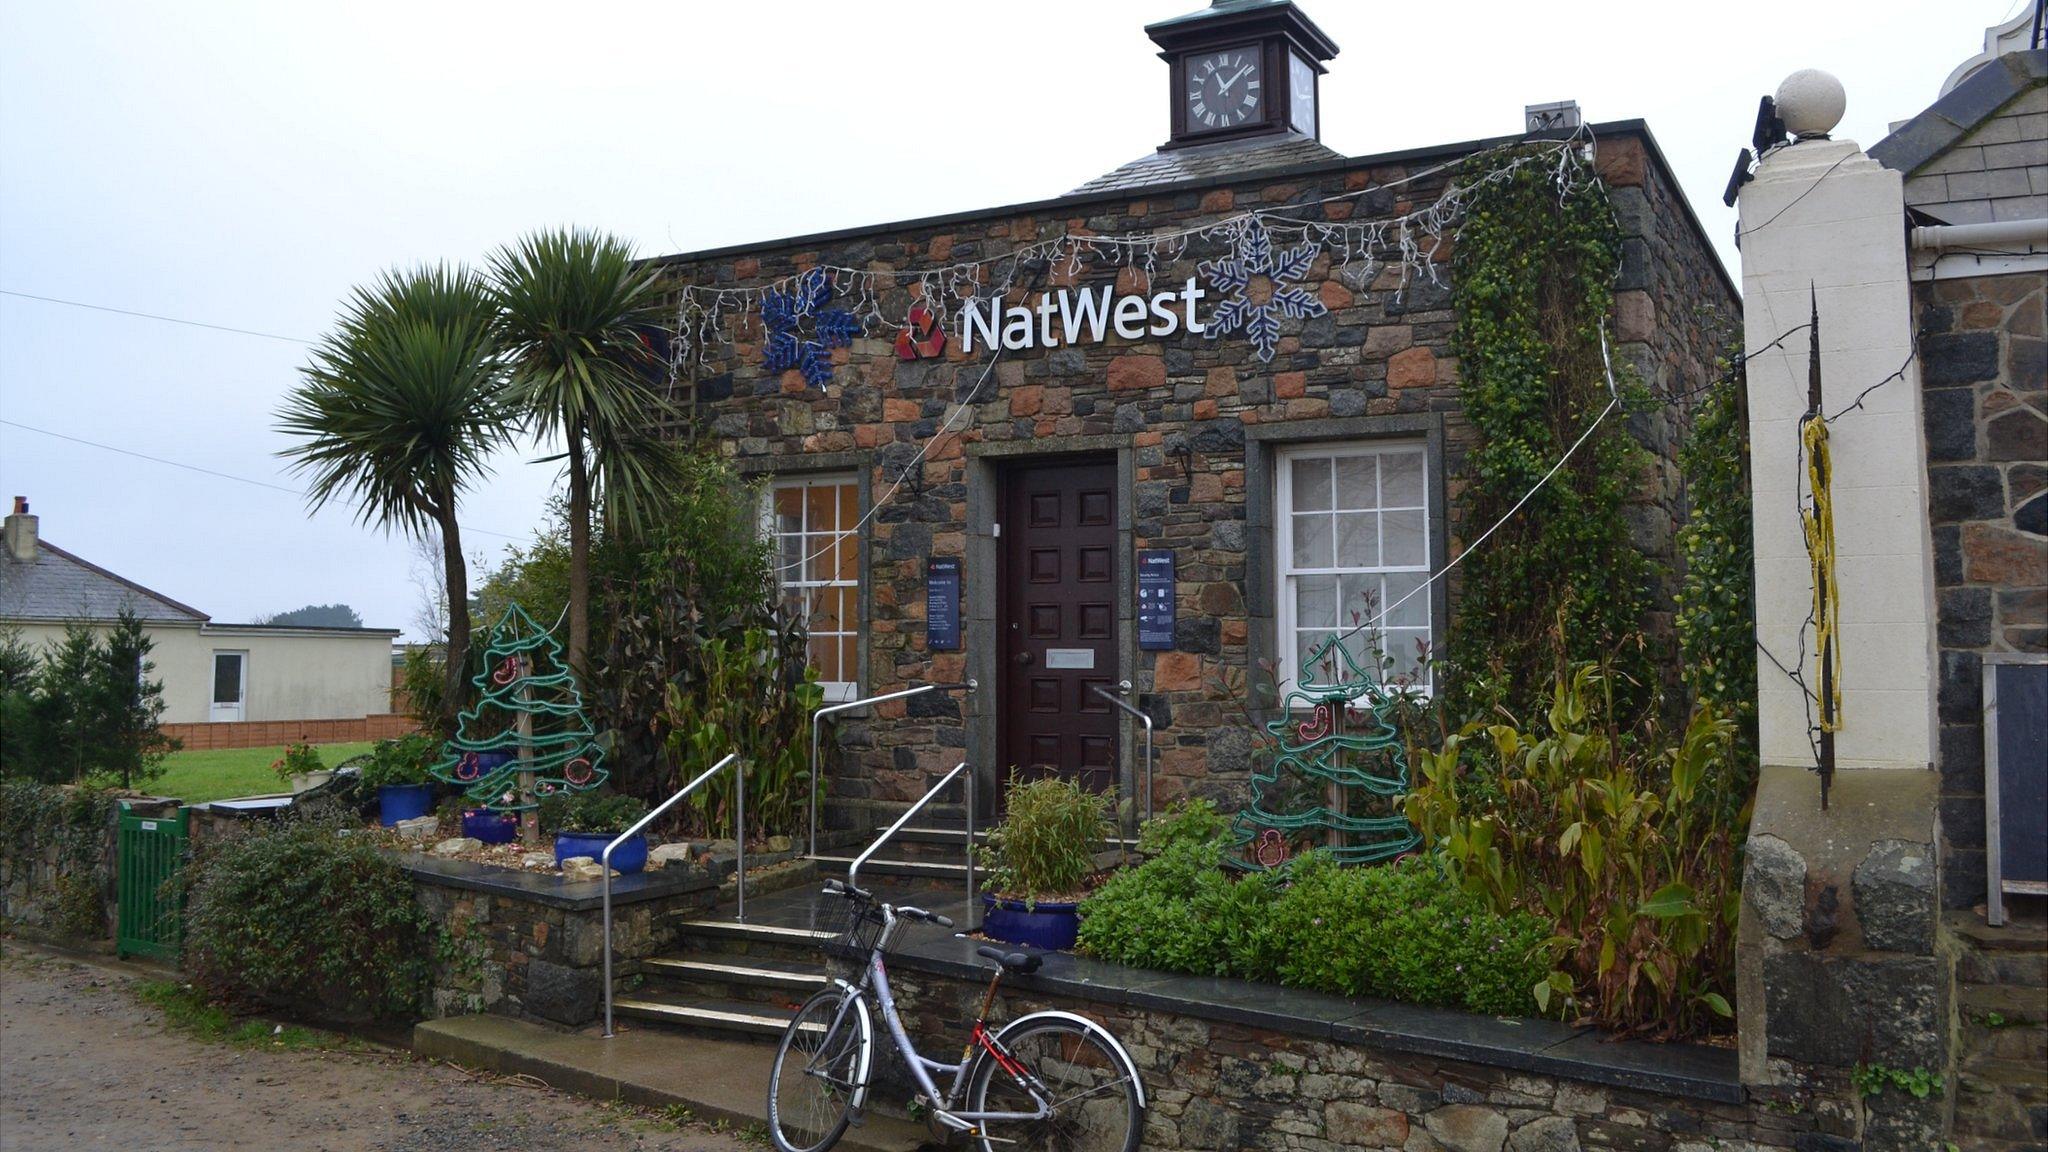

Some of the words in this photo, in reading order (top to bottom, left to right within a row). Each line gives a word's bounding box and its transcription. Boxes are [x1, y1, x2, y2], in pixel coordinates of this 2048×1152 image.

[1234, 55, 1242, 68] I
[1192, 74, 1205, 85] X
[1236, 108, 1246, 121] V
[962, 276, 1206, 353] NatWest
